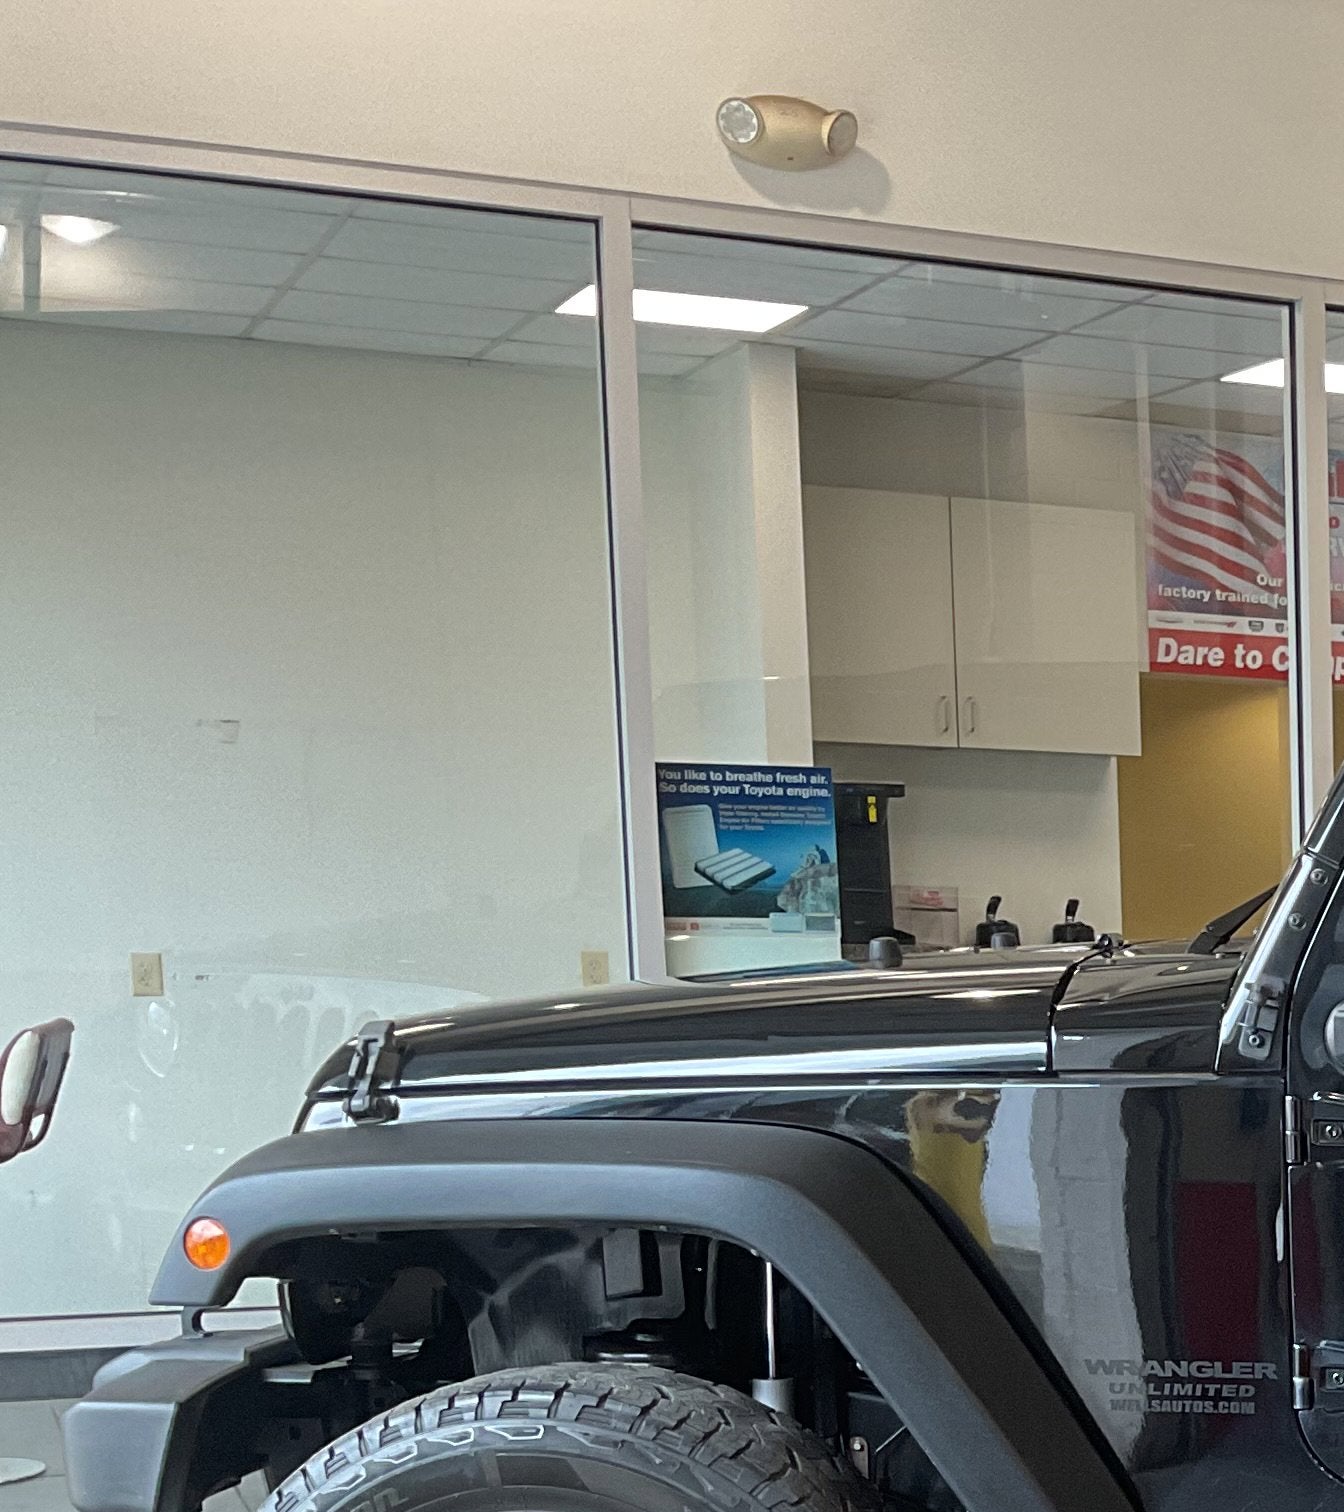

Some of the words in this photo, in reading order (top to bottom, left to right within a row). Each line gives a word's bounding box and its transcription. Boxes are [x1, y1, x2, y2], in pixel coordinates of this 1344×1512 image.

[1256, 573, 1284, 587] Our
[1158, 584, 1211, 602] factory
[1215, 588, 1268, 605] trained
[1273, 593, 1288, 609] fo
[1156, 637, 1225, 667] Dare
[1234, 643, 1263, 669] to
[658, 769, 681, 780] You
[684, 769, 707, 780] like
[709, 770, 723, 781] to
[725, 770, 773, 783] breathe
[776, 772, 807, 784] fresh
[810, 773, 829, 785] air.
[659, 781, 677, 793] So
[679, 782, 711, 794] does
[712, 785, 741, 796] your
[743, 784, 784, 797] Toyota
[787, 785, 832, 799] engine.
[1083, 1358, 1278, 1380] WRANGLER
[1108, 1382, 1256, 1398] UNLIMITED
